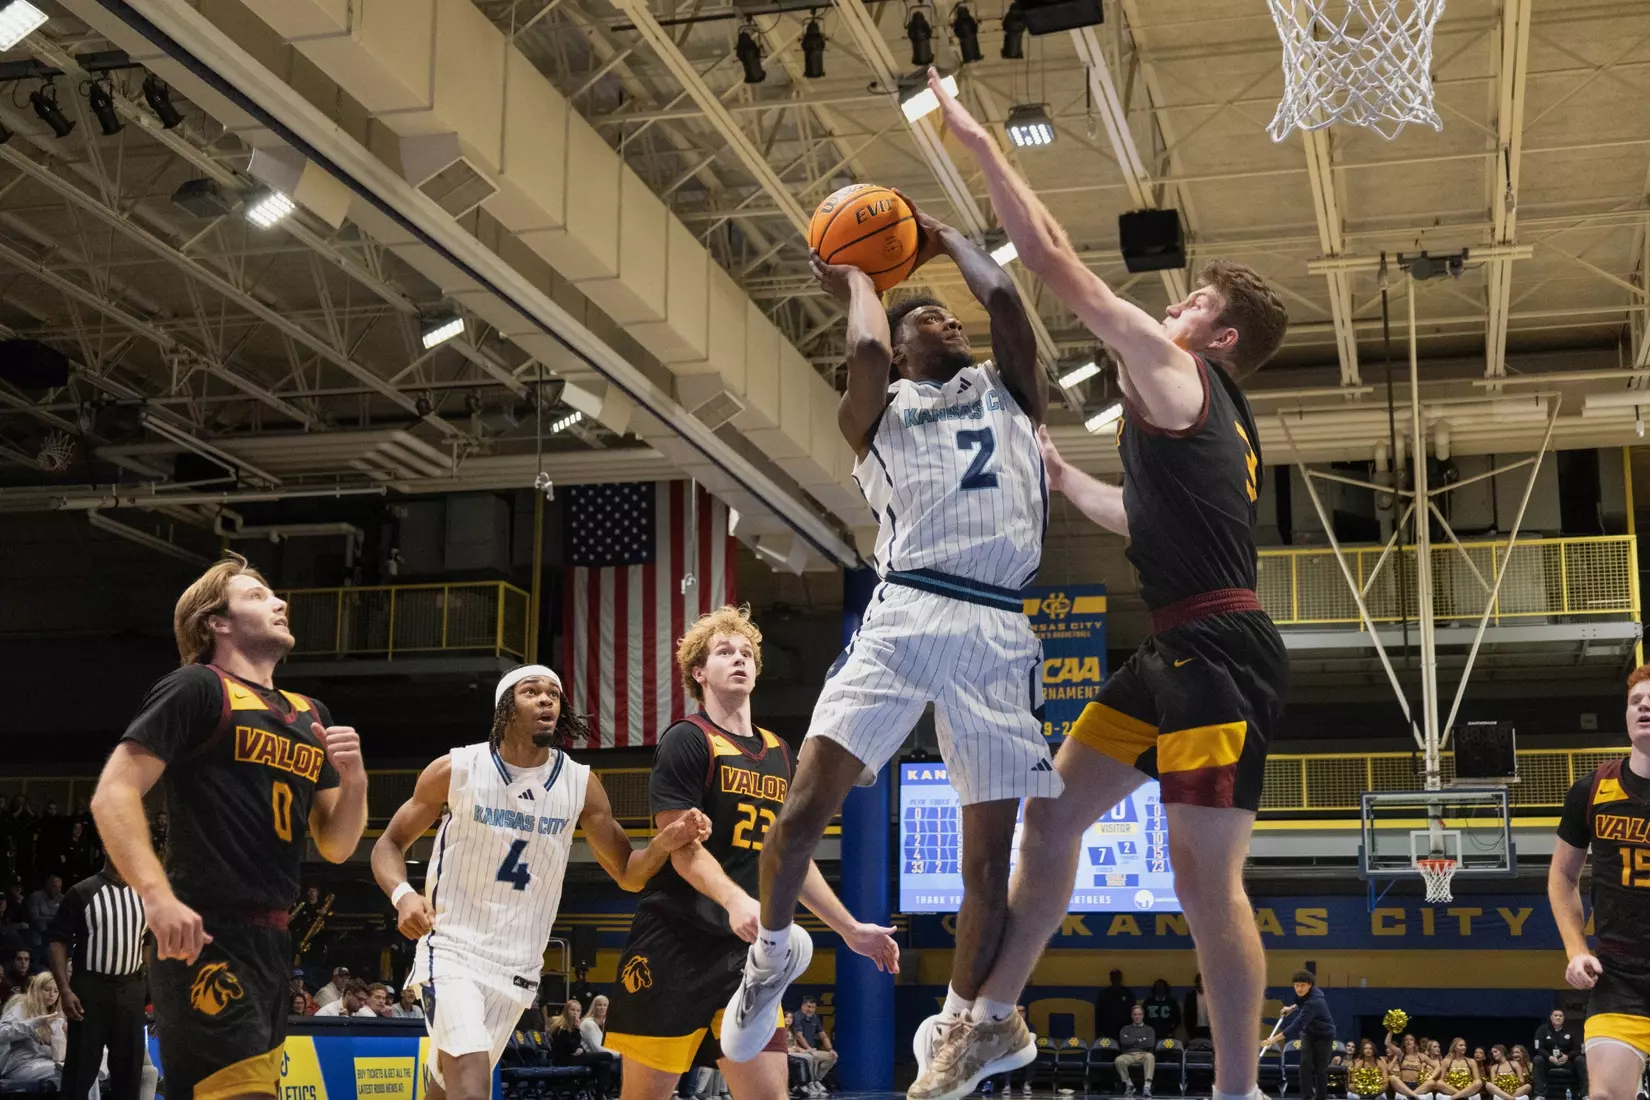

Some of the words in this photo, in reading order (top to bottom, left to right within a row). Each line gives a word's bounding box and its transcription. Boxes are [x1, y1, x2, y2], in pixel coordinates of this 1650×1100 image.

[903, 401, 985, 428] KANSAS
[956, 427, 1000, 491] 2
[1031, 622, 1067, 632] NSAS
[1070, 621, 1103, 630] CITY
[1042, 656, 1101, 684] CAA
[1042, 686, 1100, 700] RNAMENT
[234, 725, 325, 784] VALOR
[907, 770, 950, 780] KAN
[720, 764, 788, 804] VALOR
[272, 781, 293, 843] 0
[914, 807, 922, 820] 0
[937, 807, 942, 820] 1
[1100, 799, 1126, 820] 0
[1153, 804, 1162, 817] 0
[474, 804, 535, 833] KANSAS
[538, 816, 570, 835] CITY
[1154, 818, 1161, 831] 3
[916, 820, 920, 833] 1
[937, 820, 942, 833] 1
[1101, 823, 1131, 834] VISITOR
[1595, 814, 1650, 844] VAL
[914, 834, 922, 847] 2
[937, 834, 942, 847] 1
[1152, 832, 1163, 845] 10
[913, 848, 922, 861] 4
[937, 847, 942, 860] 1
[1124, 843, 1130, 853] 2
[1153, 846, 1163, 859] 15
[1099, 848, 1106, 863] 7
[495, 838, 531, 891] 4
[911, 861, 925, 874] 33
[935, 861, 942, 874] 2
[1151, 860, 1165, 873] 23
[915, 895, 946, 905] THANK
[950, 895, 962, 905] YO
[1070, 895, 1112, 904] RTNERS
[1060, 907, 1329, 937] KANAS
[1371, 907, 1534, 936] CITY
[357, 1068, 366, 1079] BUY
[366, 1068, 384, 1079] TICKETS
[403, 1067, 411, 1078] THE
[358, 1083, 373, 1095] LATEST
